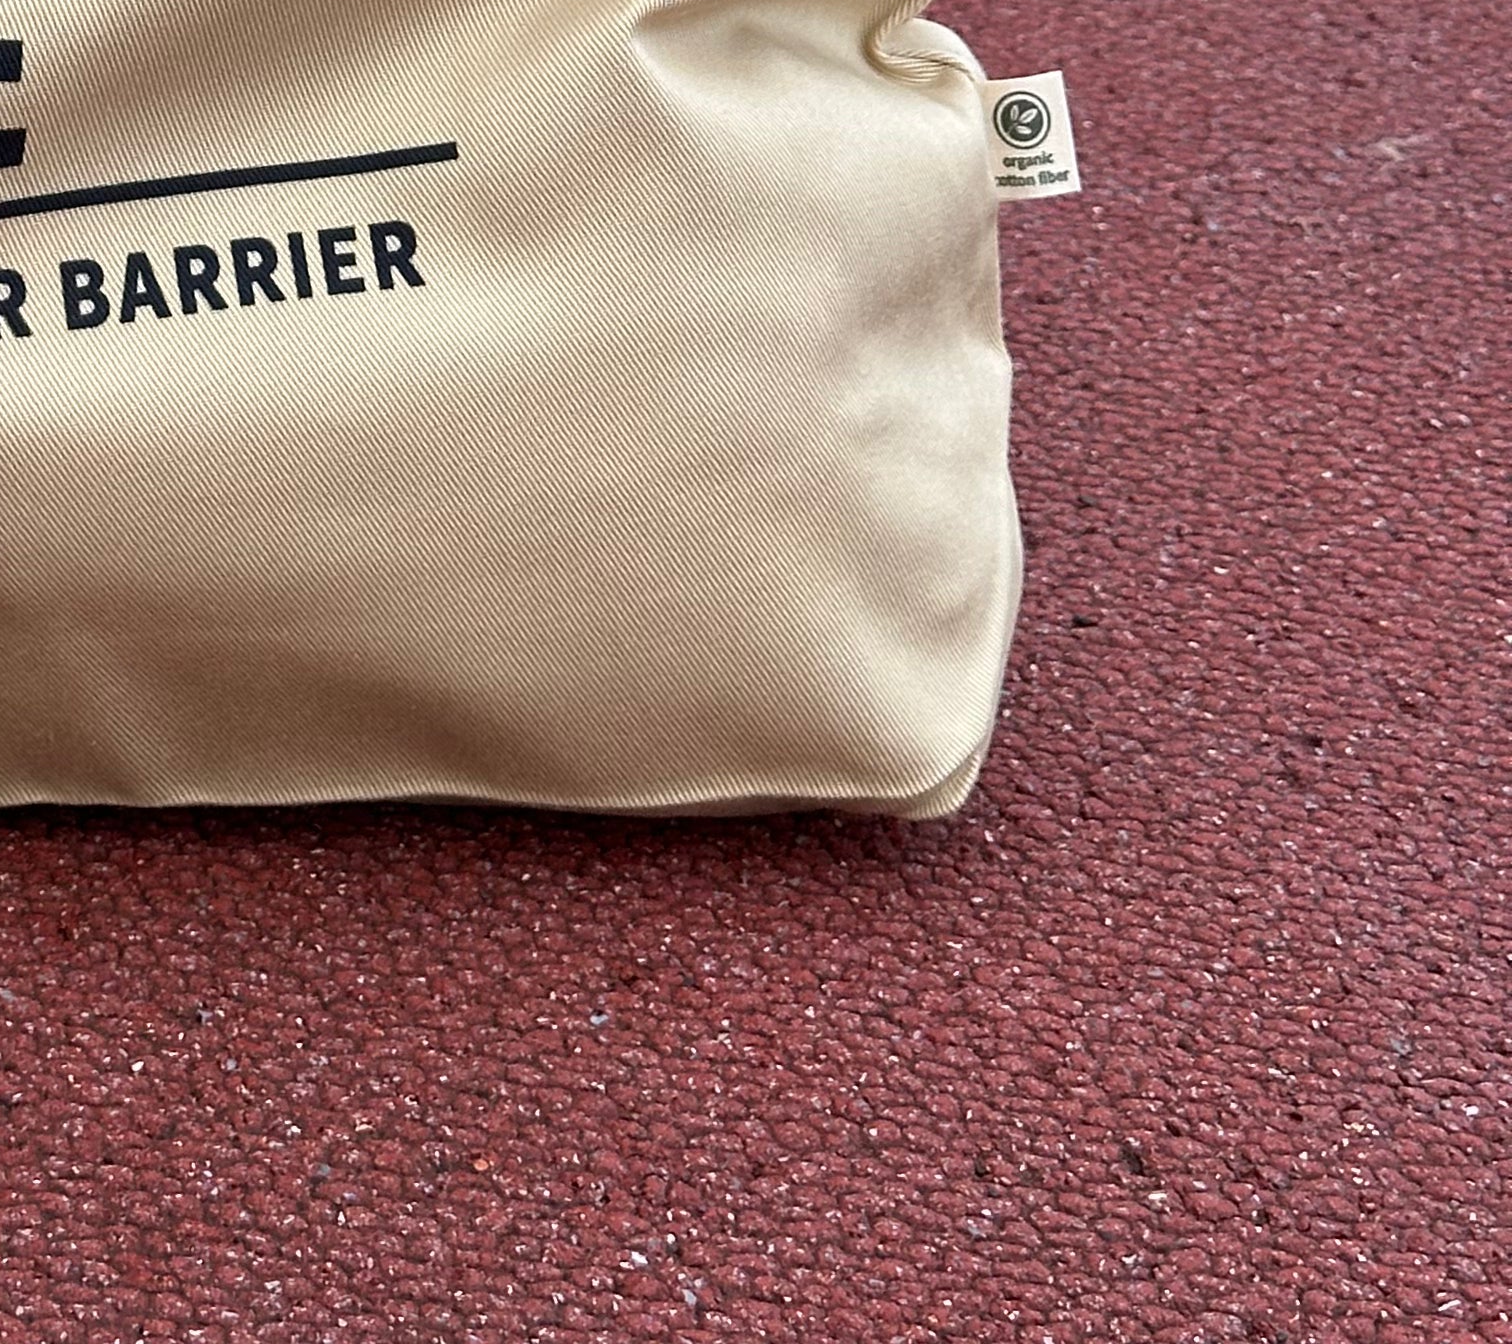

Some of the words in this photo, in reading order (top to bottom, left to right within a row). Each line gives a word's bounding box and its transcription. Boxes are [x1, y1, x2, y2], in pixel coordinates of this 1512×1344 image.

[1002, 151, 1054, 171] organic
[1038, 170, 1070, 186] fiber
[59, 220, 425, 331] BARRIER
